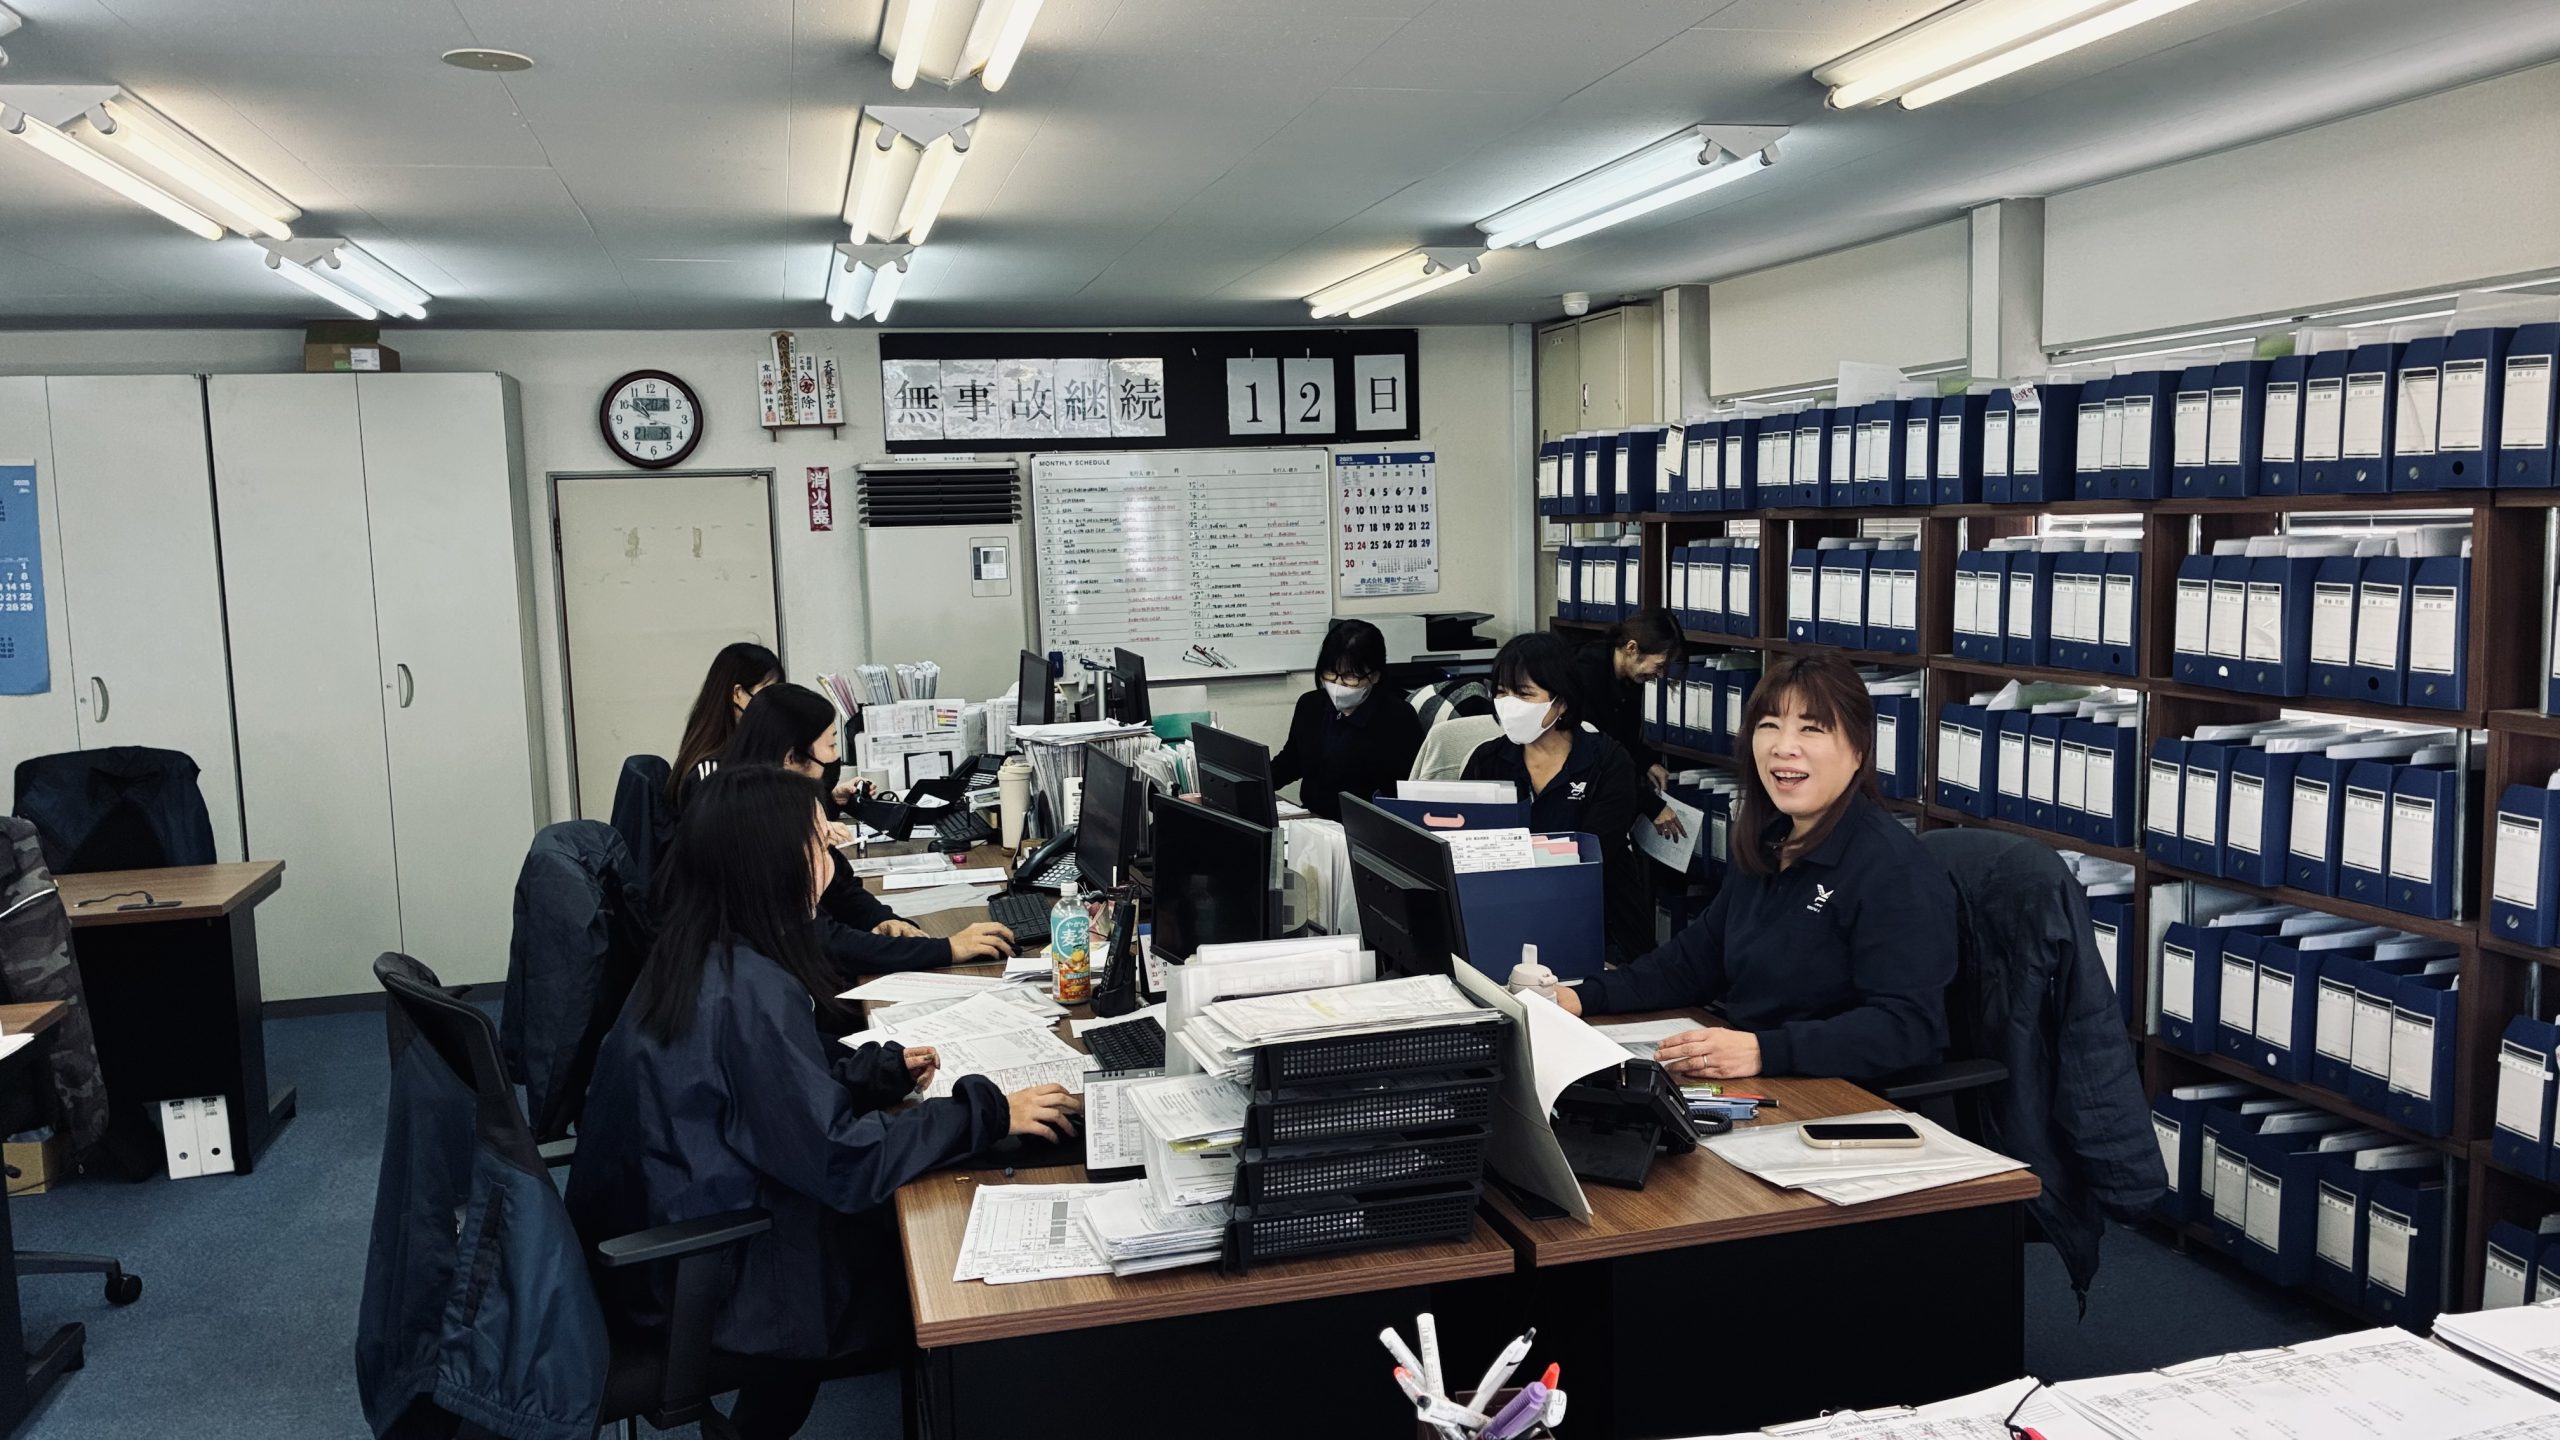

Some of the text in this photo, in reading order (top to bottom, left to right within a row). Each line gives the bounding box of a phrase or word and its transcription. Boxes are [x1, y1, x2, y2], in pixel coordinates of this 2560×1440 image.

[631, 388, 639, 397] 11
[646, 384, 656, 394] 12
[676, 400, 682, 409] 2
[896, 377, 1163, 424] 無事故継続
[1370, 376, 1399, 415] 日
[616, 415, 623, 424] 9
[681, 415, 688, 424] 3
[622, 430, 629, 440] 8
[676, 431, 683, 439] 4
[635, 442, 641, 451] 7
[651, 446, 657, 455] 6
[666, 442, 673, 451] 5
[1344, 489, 1349, 497] 2
[1357, 489, 1362, 497] 3
[1370, 488, 1375, 496] 4
[1383, 488, 1388, 496] 5
[1409, 487, 1414, 495] 7
[1422, 487, 1427, 495] 8
[811, 471, 830, 524] 消火器
[1345, 507, 1350, 515] 9
[1356, 506, 1364, 514] 10
[1370, 506, 1377, 514] 11
[1382, 506, 1390, 514] 12
[1395, 505, 1403, 513] 13
[1421, 504, 1429, 512] 15
[1344, 524, 1352, 532] 16
[1357, 524, 1364, 532] 17
[1370, 524, 1377, 532] 18
[1383, 523, 1390, 531] 19
[1409, 522, 1416, 530] 21
[1345, 542, 1353, 550] 23
[1370, 541, 1379, 549] 25
[1396, 540, 1404, 548] 27
[1421, 539, 1430, 547] 29
[1345, 560, 1355, 568] 30
[7, 572, 13, 580] 7
[6, 582, 31, 591] 14 15
[6, 592, 32, 601] 21 22
[6, 603, 19, 611] 28
[1061, 928, 1089, 947] 麦茶
